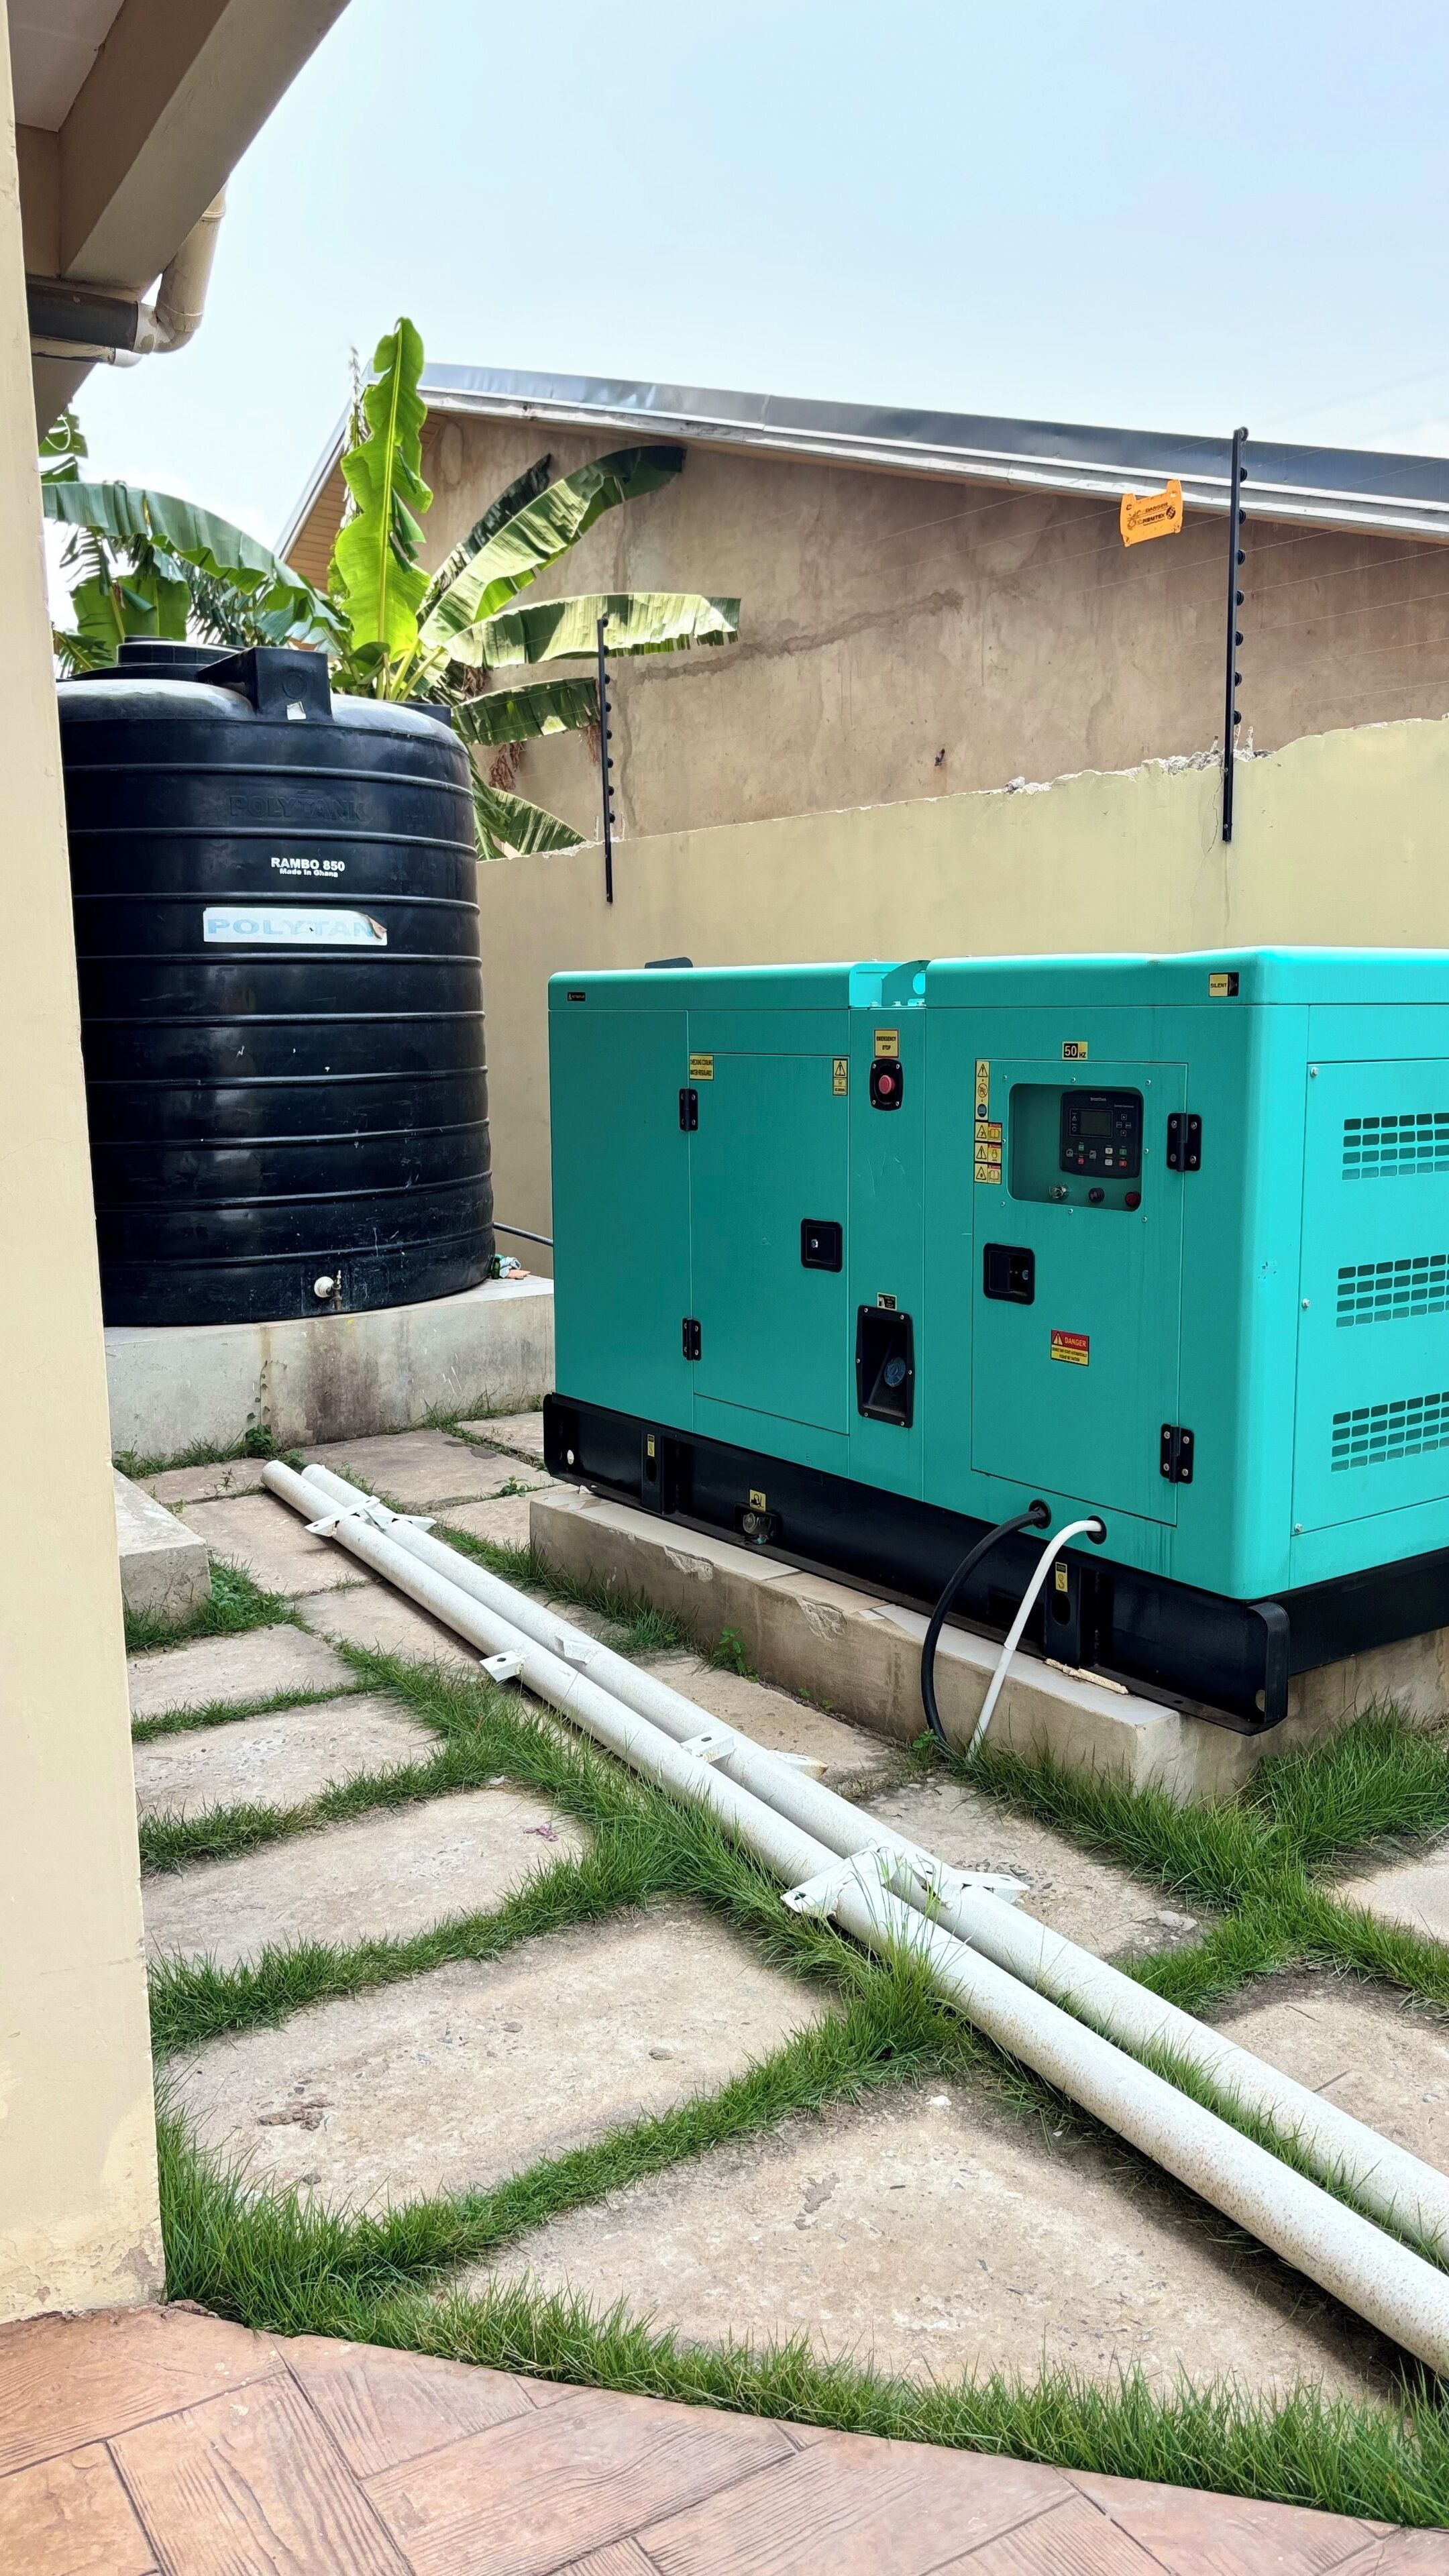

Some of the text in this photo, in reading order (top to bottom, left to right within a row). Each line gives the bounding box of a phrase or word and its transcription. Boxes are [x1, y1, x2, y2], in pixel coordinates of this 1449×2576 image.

[230, 796, 366, 821] POLYTANK
[270, 857, 345, 871] RAMBO 850
[313, 869, 339, 877] Ghana
[1065, 1045, 1077, 1057] 50
[1065, 1337, 1087, 1347] DANGER
